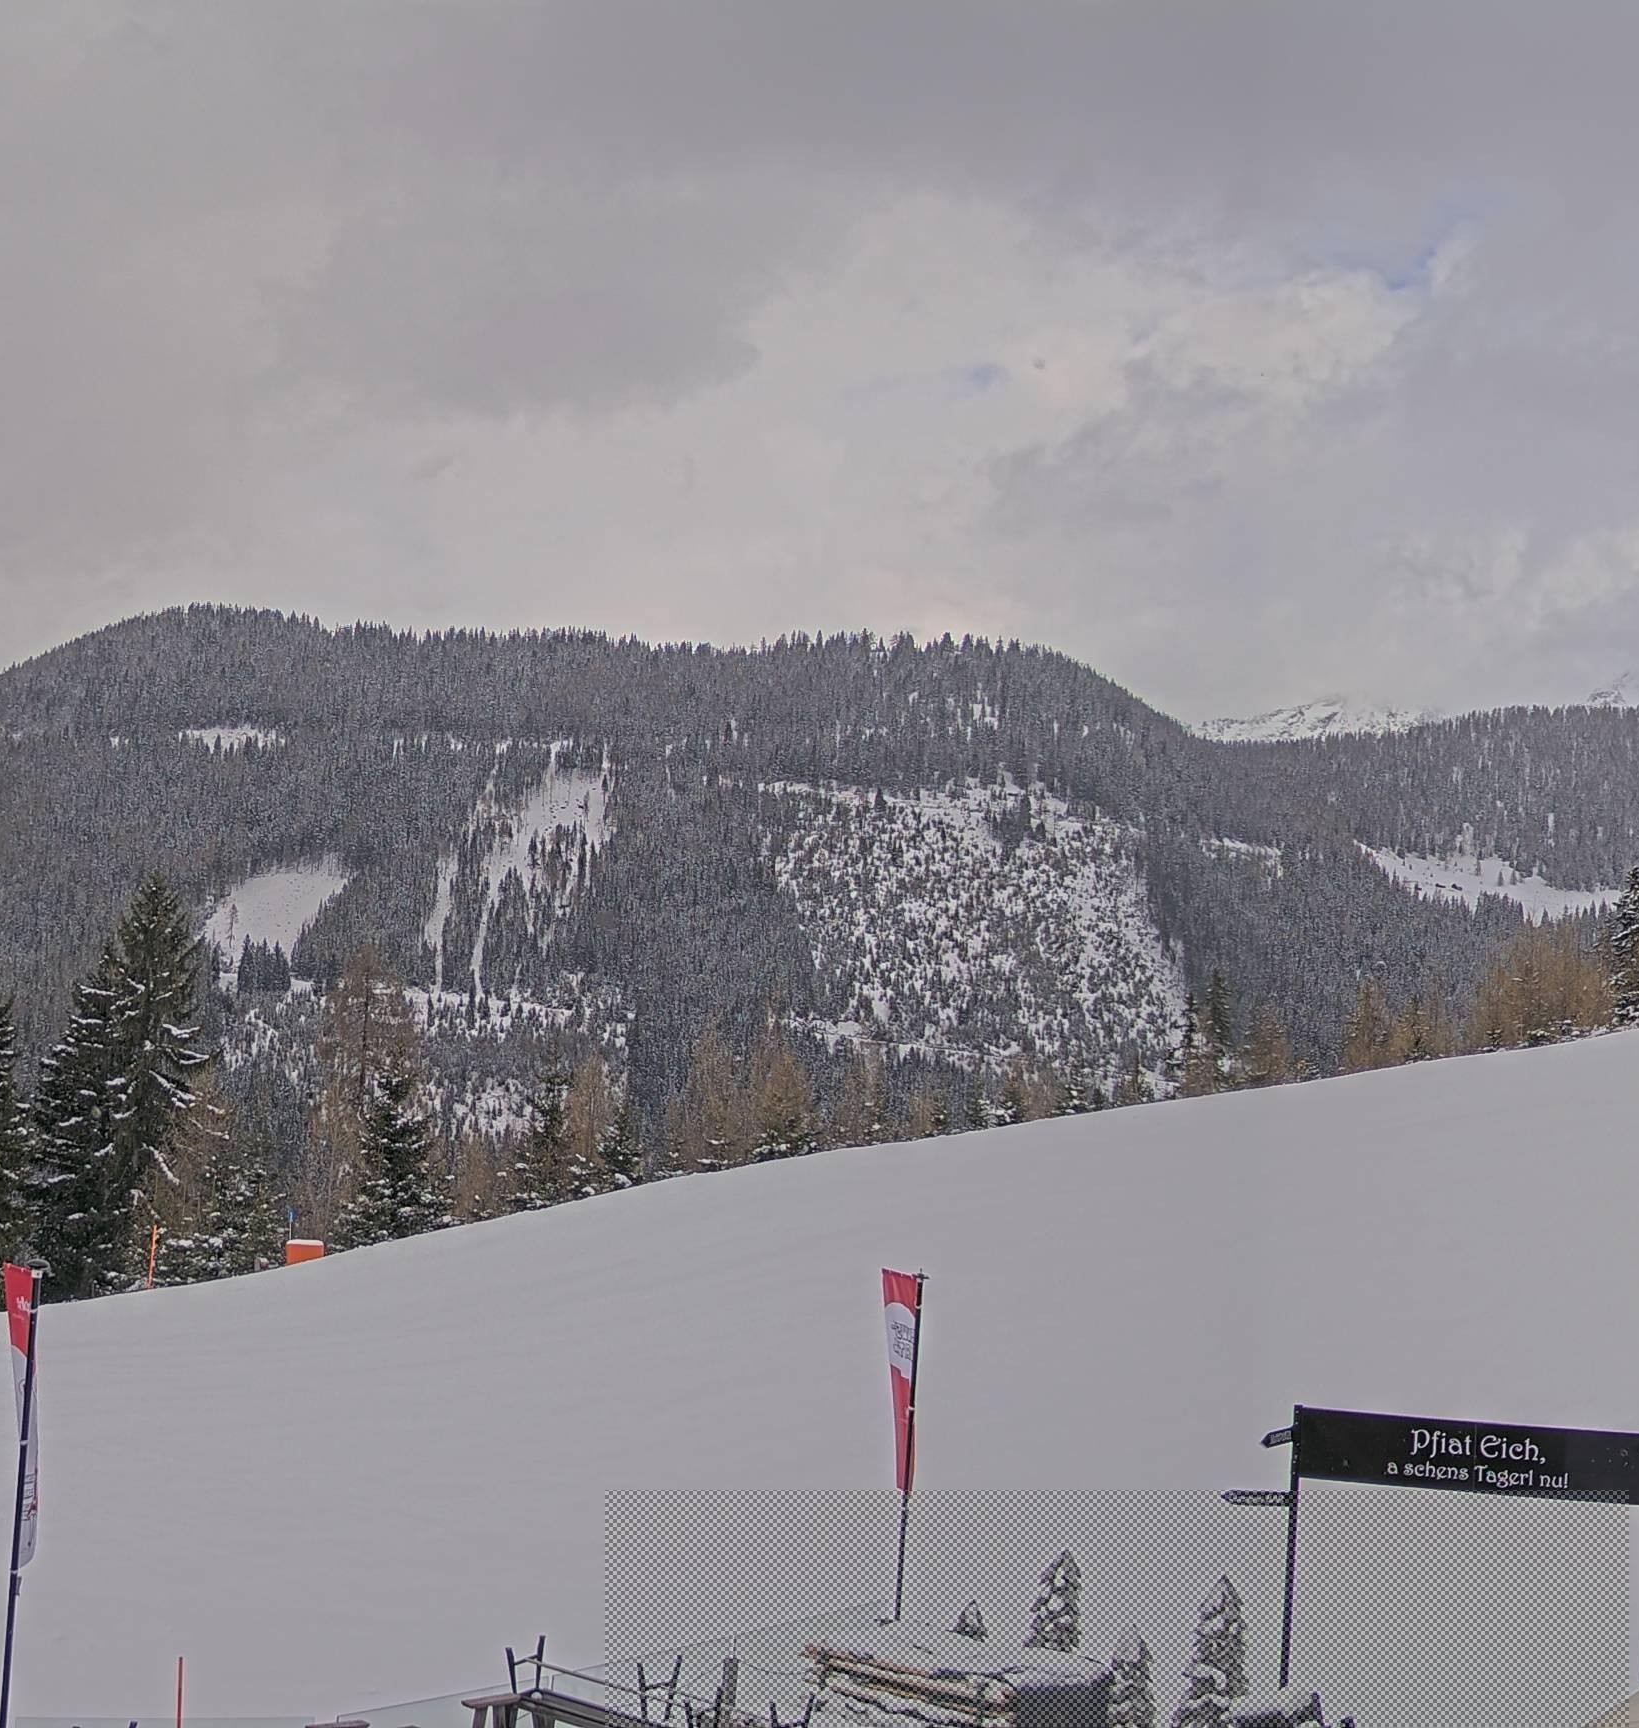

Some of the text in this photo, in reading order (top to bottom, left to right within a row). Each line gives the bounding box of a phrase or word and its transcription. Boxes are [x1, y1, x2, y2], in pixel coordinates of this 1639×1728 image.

[1409, 1428, 1547, 1465] Pfiat Eich,
[1386, 1461, 1570, 1490] a schens Tagerl nu!
